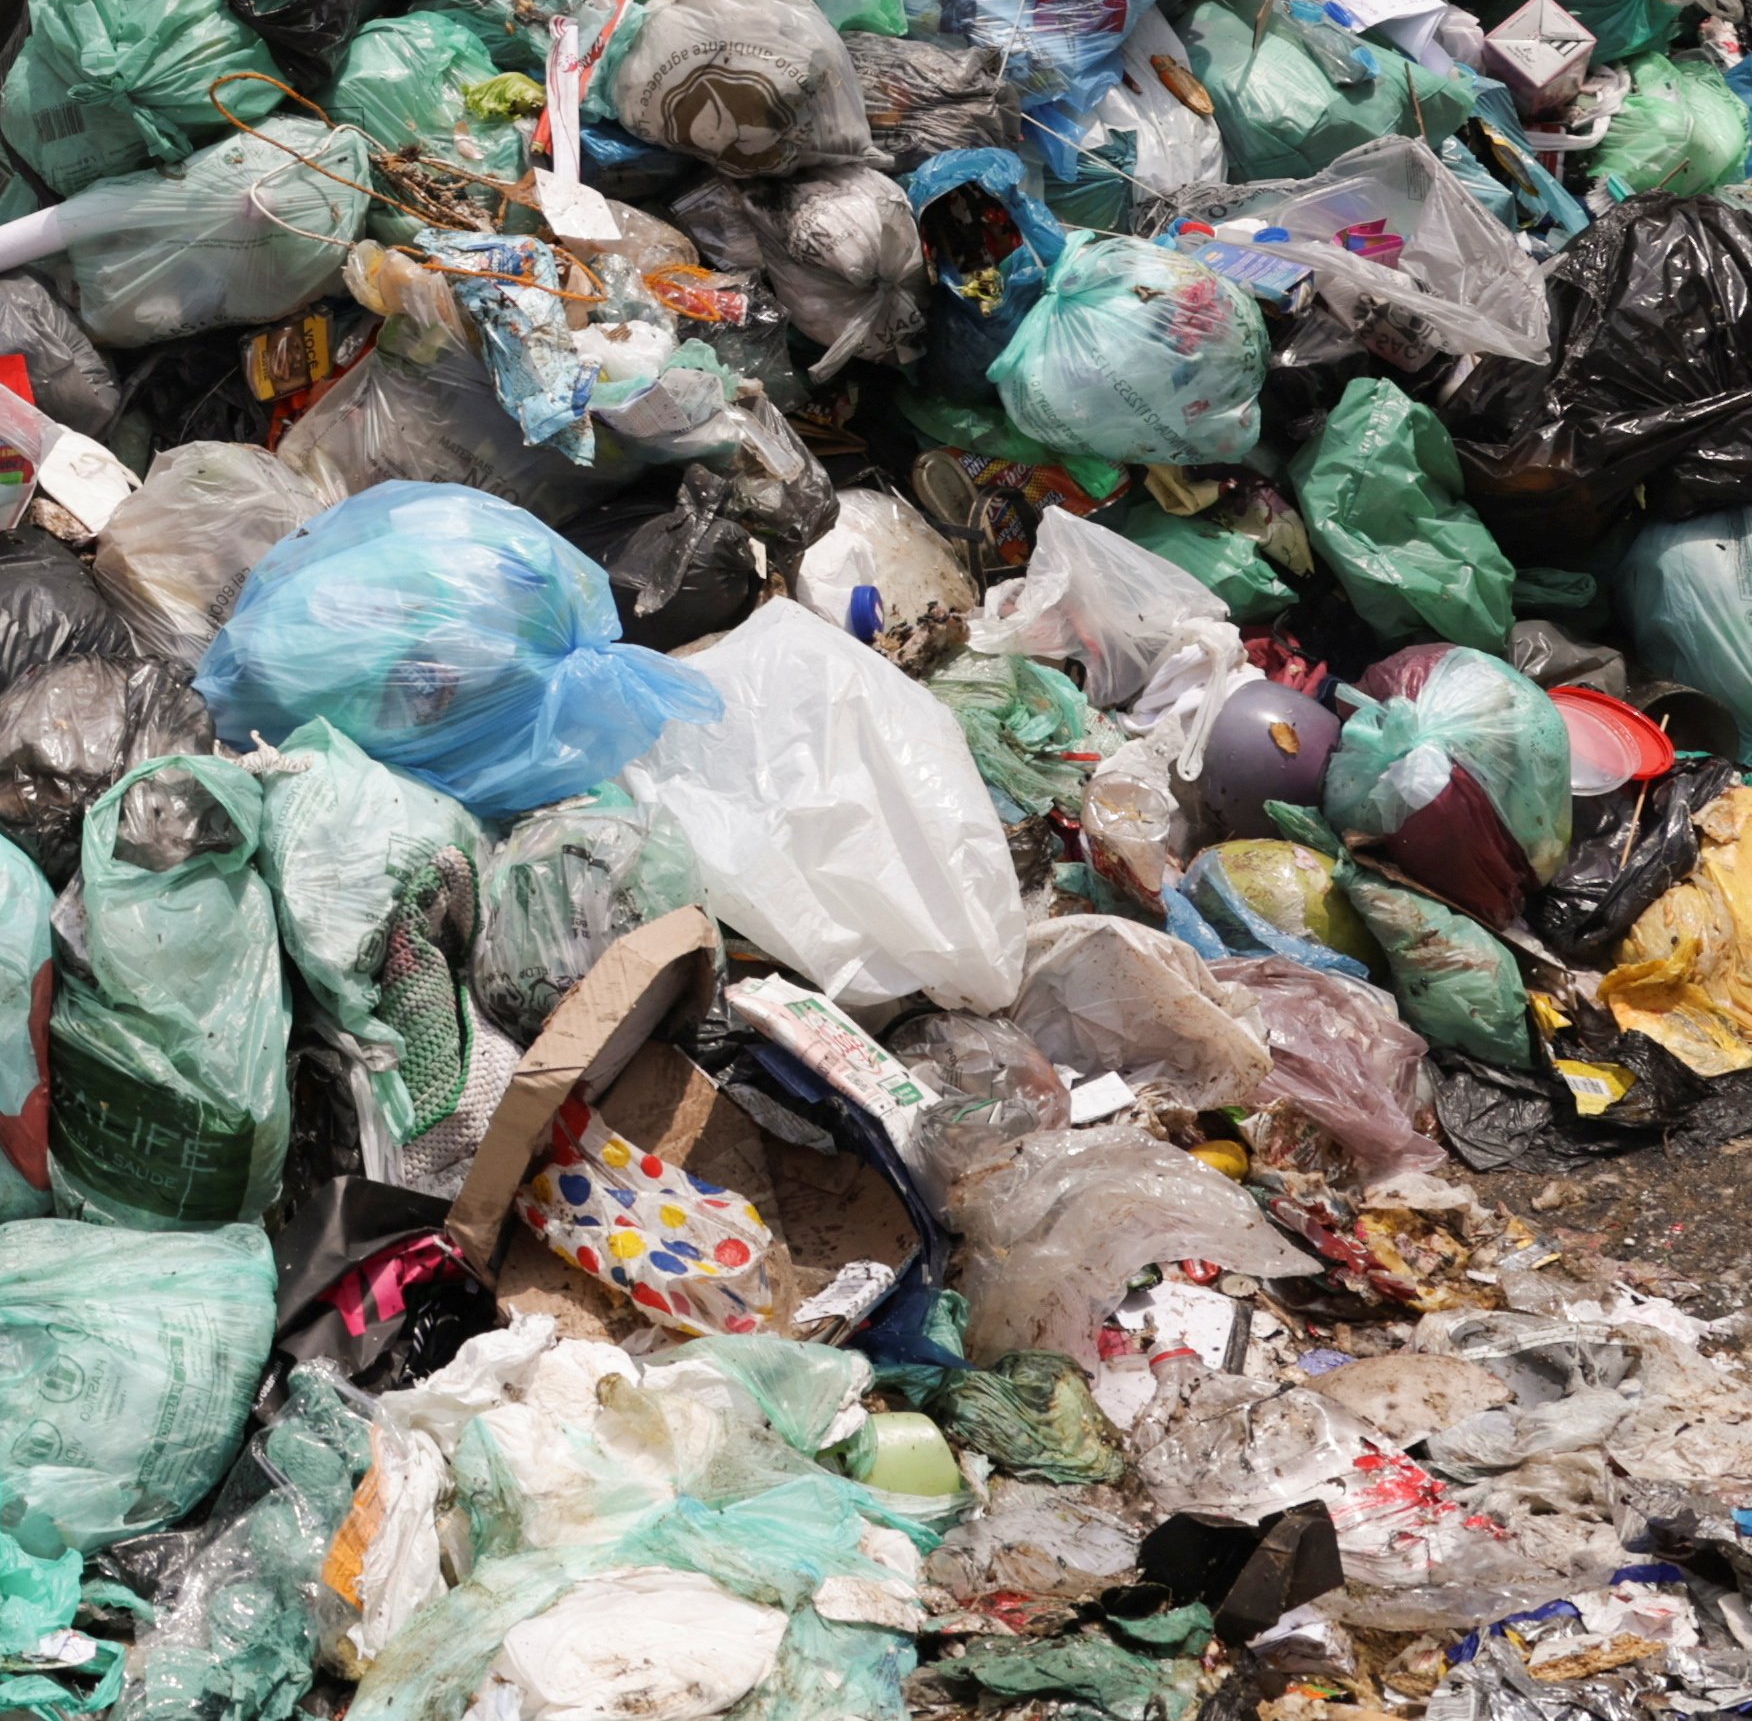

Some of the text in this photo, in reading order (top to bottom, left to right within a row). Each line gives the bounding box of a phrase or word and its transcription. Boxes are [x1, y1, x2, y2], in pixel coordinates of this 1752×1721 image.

[693, 38, 777, 61] ambiente
[644, 46, 690, 108] agradece
[303, 326, 321, 373] VOCÊ
[438, 435, 495, 475] MATERIAIS
[463, 465, 520, 506] NÃO
